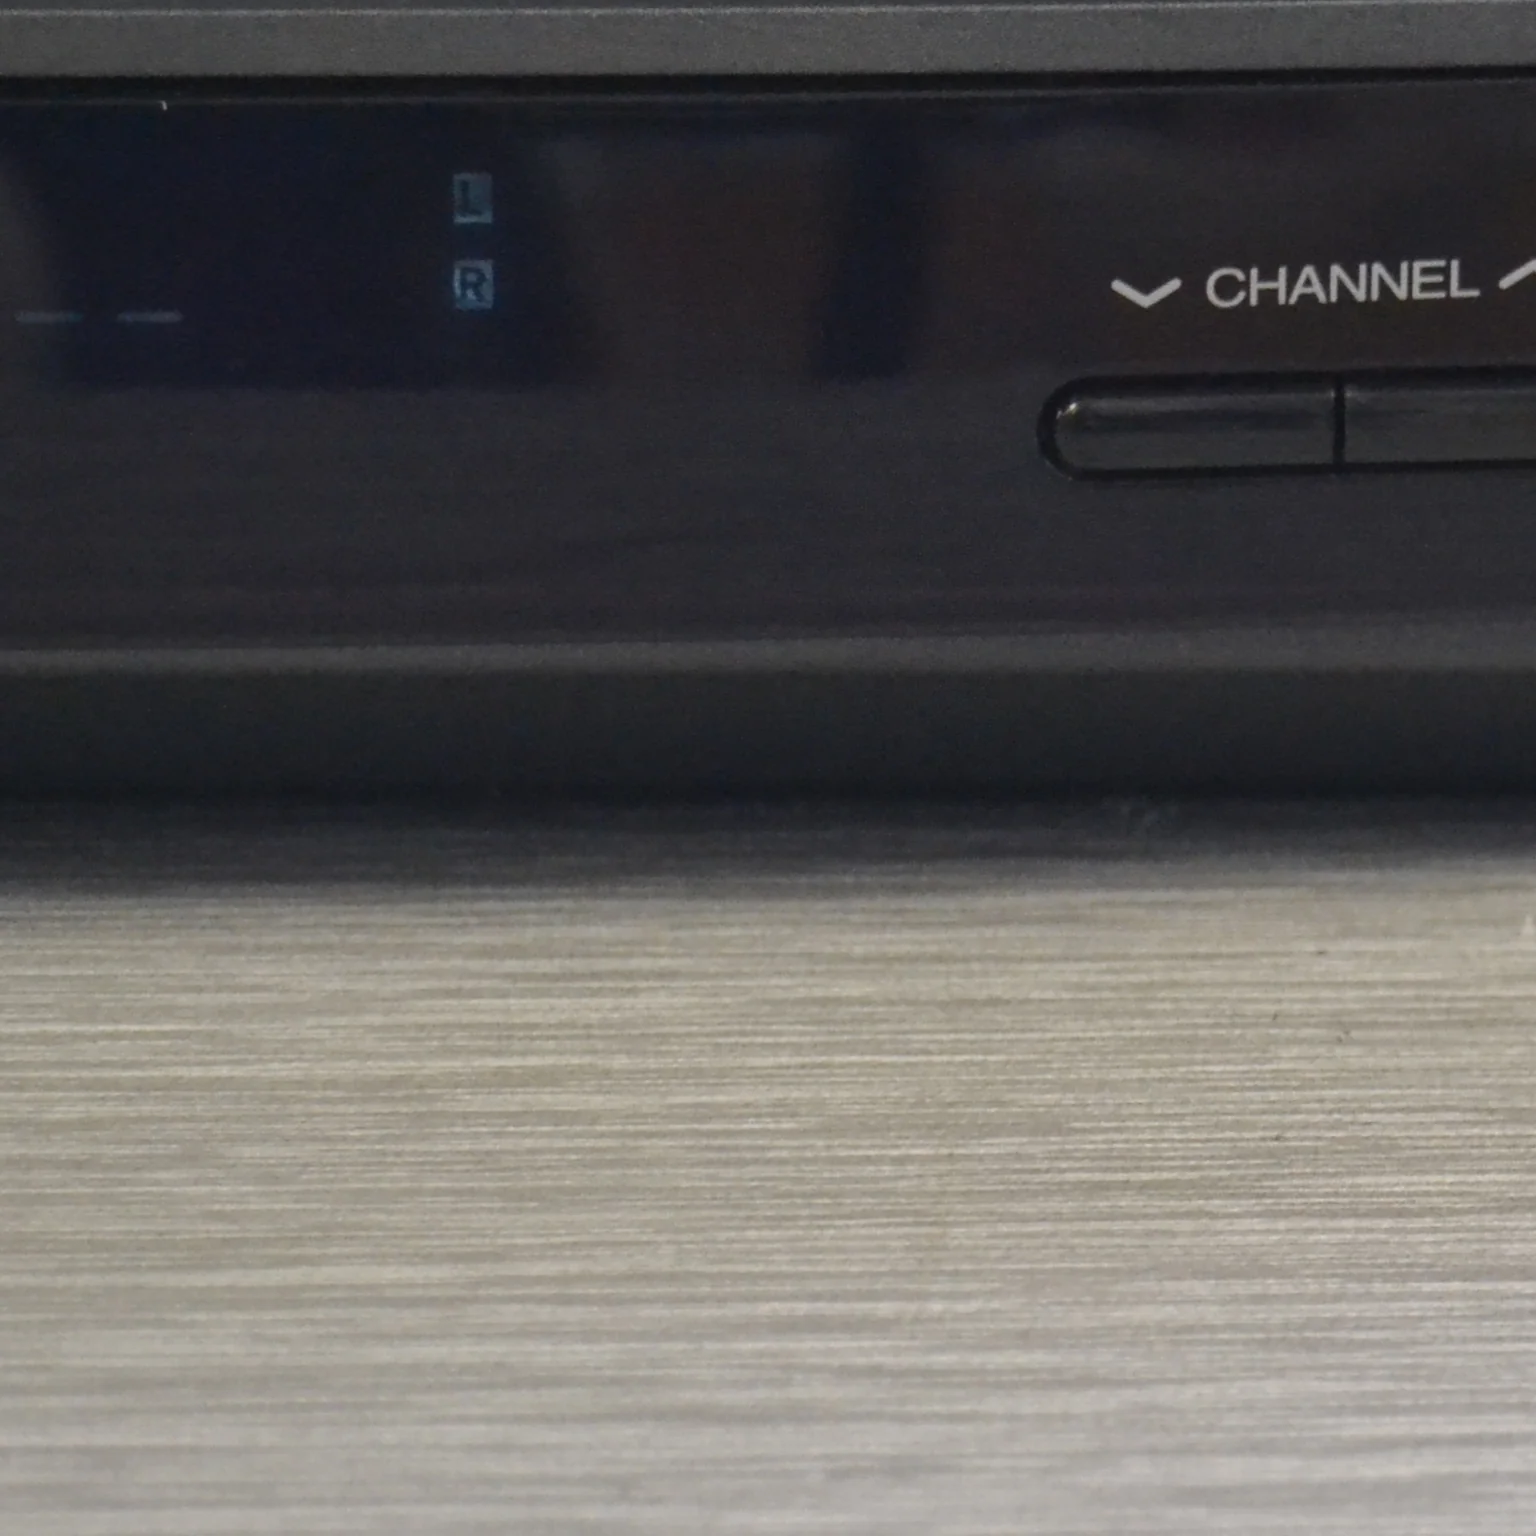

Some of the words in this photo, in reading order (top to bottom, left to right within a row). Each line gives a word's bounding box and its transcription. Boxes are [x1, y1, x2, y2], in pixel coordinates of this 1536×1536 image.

[455, 176, 491, 221] L
[456, 263, 491, 306] R
[1205, 258, 1481, 309] CHANNEL
